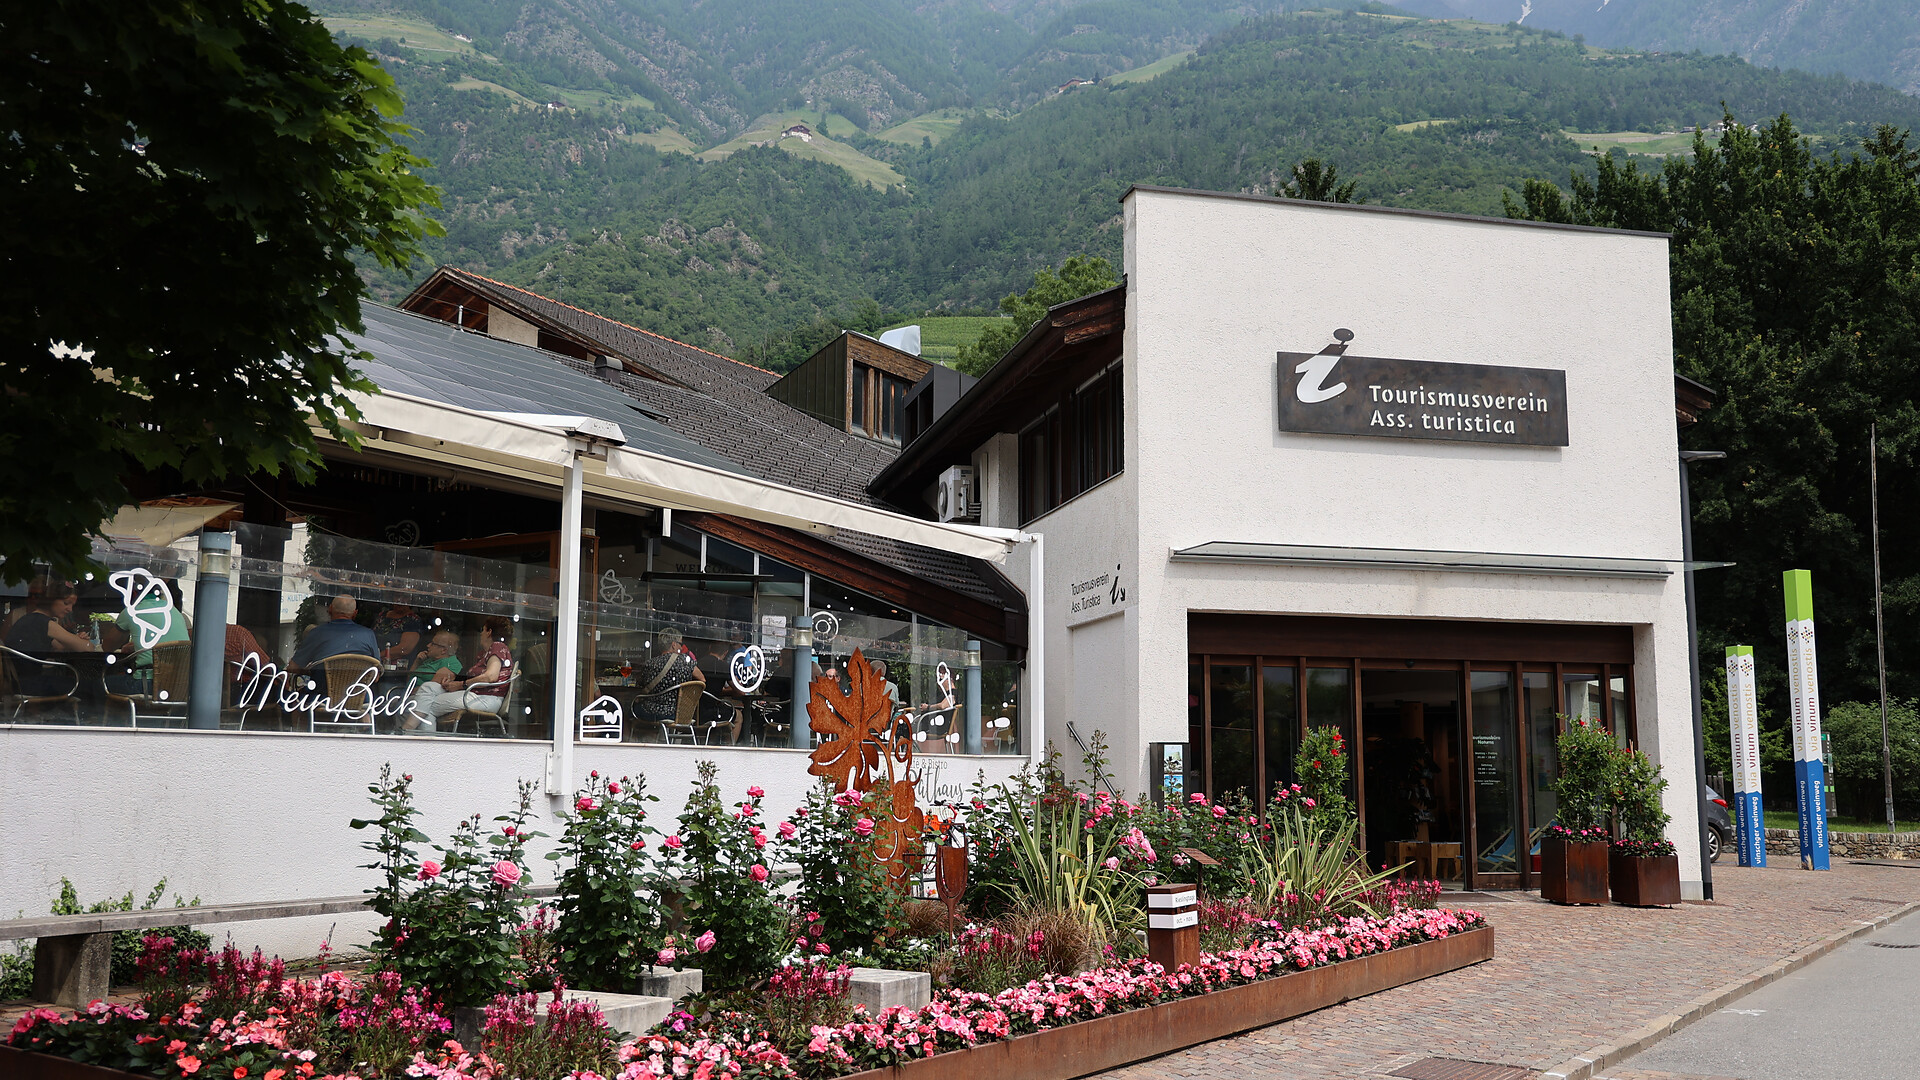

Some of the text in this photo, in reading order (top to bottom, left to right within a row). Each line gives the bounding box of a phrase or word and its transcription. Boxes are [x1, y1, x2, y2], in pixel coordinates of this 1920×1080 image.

[1368, 385, 1549, 413] Tourismusverein
[1370, 409, 1516, 435] Ass. turistica
[1071, 572, 1110, 596] Tourismusverein
[1790, 648, 1803, 752] via vinum venostis
[1803, 647, 1818, 752] via vinum venostis
[928, 758, 948, 770] Bistro
[1729, 683, 1743, 788] via vinum venostis
[1742, 683, 1757, 788] via vinum venostis
[1751, 796, 1762, 865] vinschger weinweg
[1813, 780, 1824, 849] vinschger weinweg
